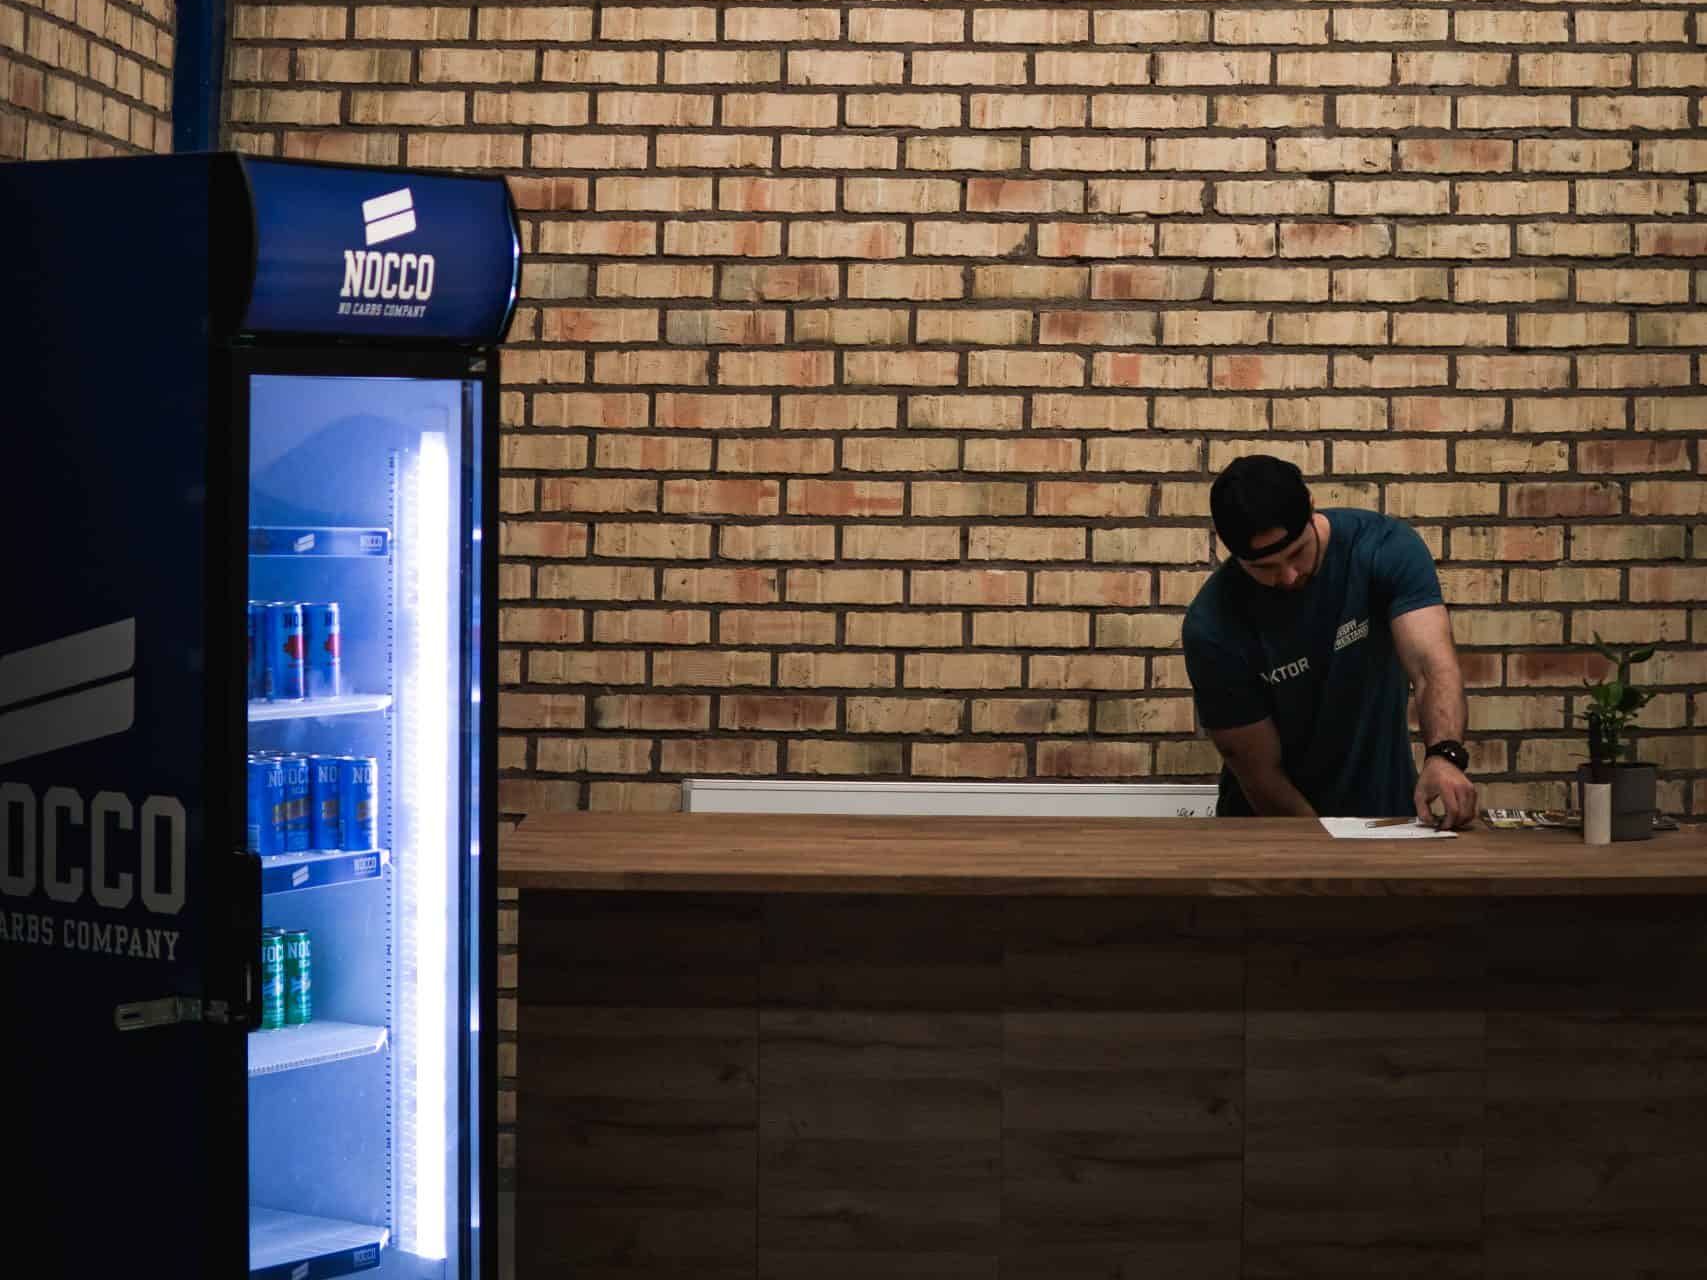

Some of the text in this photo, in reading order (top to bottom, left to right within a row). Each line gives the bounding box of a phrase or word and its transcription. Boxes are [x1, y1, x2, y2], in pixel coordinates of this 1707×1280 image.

[340, 250, 435, 301] NOCCO
[352, 303, 382, 316] CARBS
[384, 304, 426, 318] COMPANY
[63, 919, 180, 962] COMPANY
